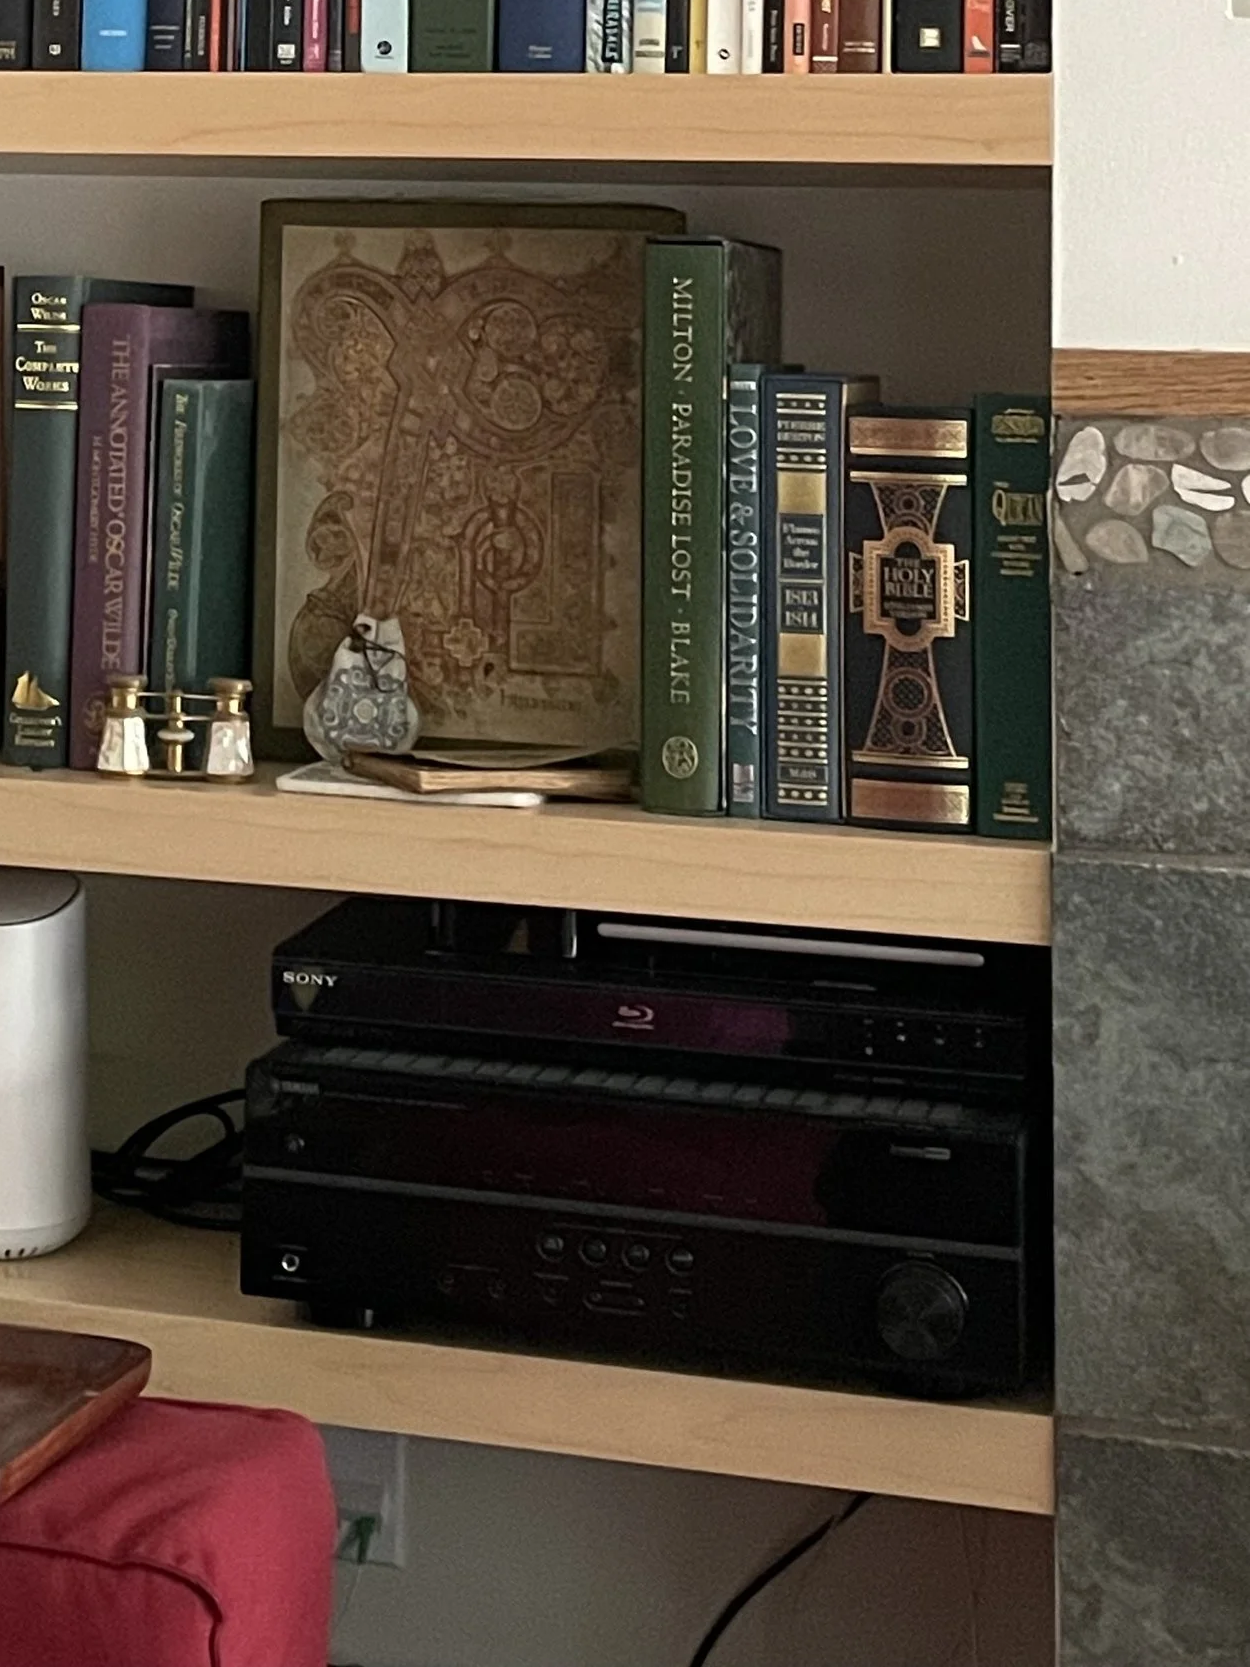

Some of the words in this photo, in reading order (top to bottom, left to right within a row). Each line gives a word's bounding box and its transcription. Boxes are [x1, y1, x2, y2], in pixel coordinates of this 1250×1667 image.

[109, 339, 130, 378] THE
[672, 277, 693, 382] MILTON
[105, 387, 129, 511] ANNOTATED
[671, 402, 691, 525] PARADISE
[729, 404, 757, 493] LOVE
[730, 502, 754, 525] &
[103, 519, 126, 593] OSCAR
[671, 534, 690, 600] LOST
[884, 567, 934, 583] HOLY
[784, 587, 819, 607] 1813
[784, 608, 819, 628] 1814
[883, 583, 934, 599] BIBLE
[101, 597, 124, 669] WILDE
[670, 621, 690, 704] BLAKE
[730, 530, 758, 734] SOLIDARITY
[283, 971, 338, 988] SONY
